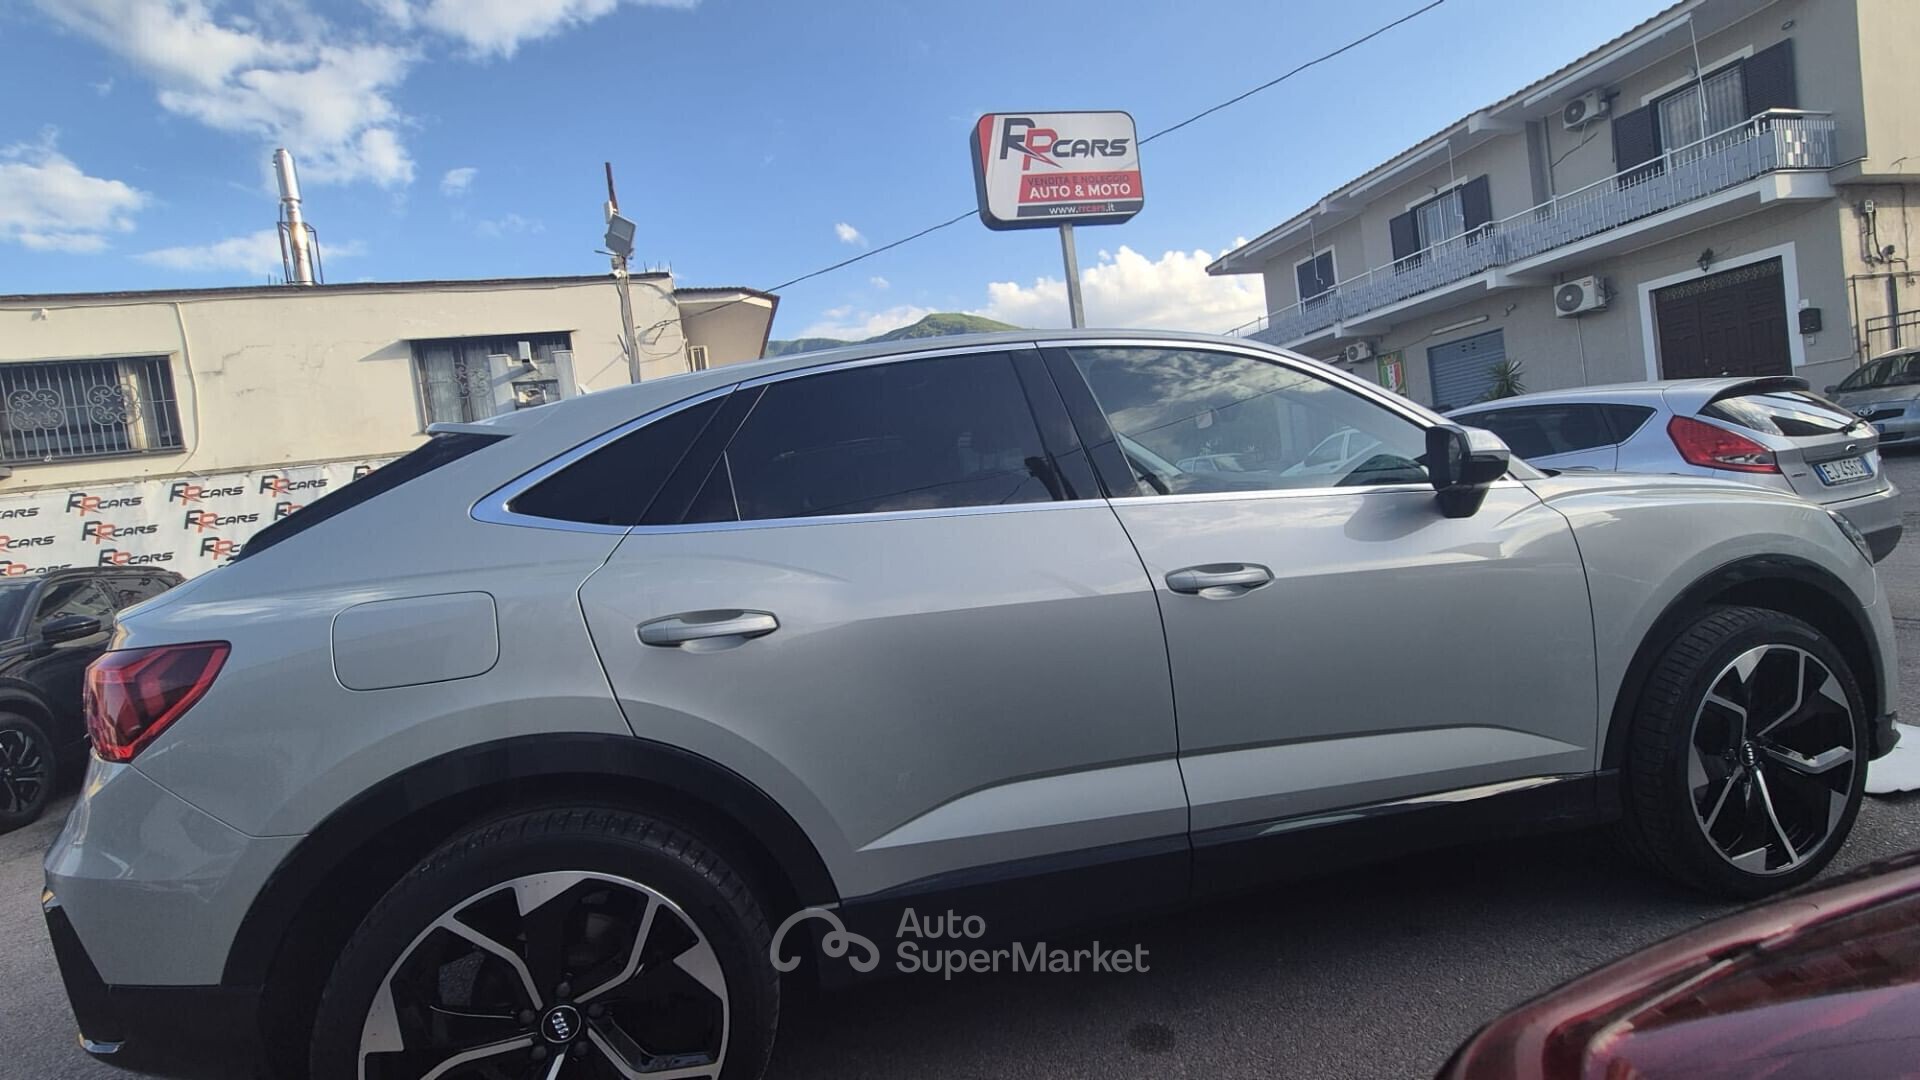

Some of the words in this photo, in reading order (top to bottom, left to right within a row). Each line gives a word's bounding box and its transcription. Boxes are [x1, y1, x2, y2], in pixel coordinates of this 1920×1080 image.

[1028, 177, 1069, 186] VENDITA
[1072, 176, 1078, 184] E
[1081, 174, 1130, 184] NOLEGGIO
[1029, 185, 1071, 199] AUTO
[1074, 184, 1085, 196] &
[1088, 183, 1131, 196] MOTO
[0, 507, 40, 519] ARS
